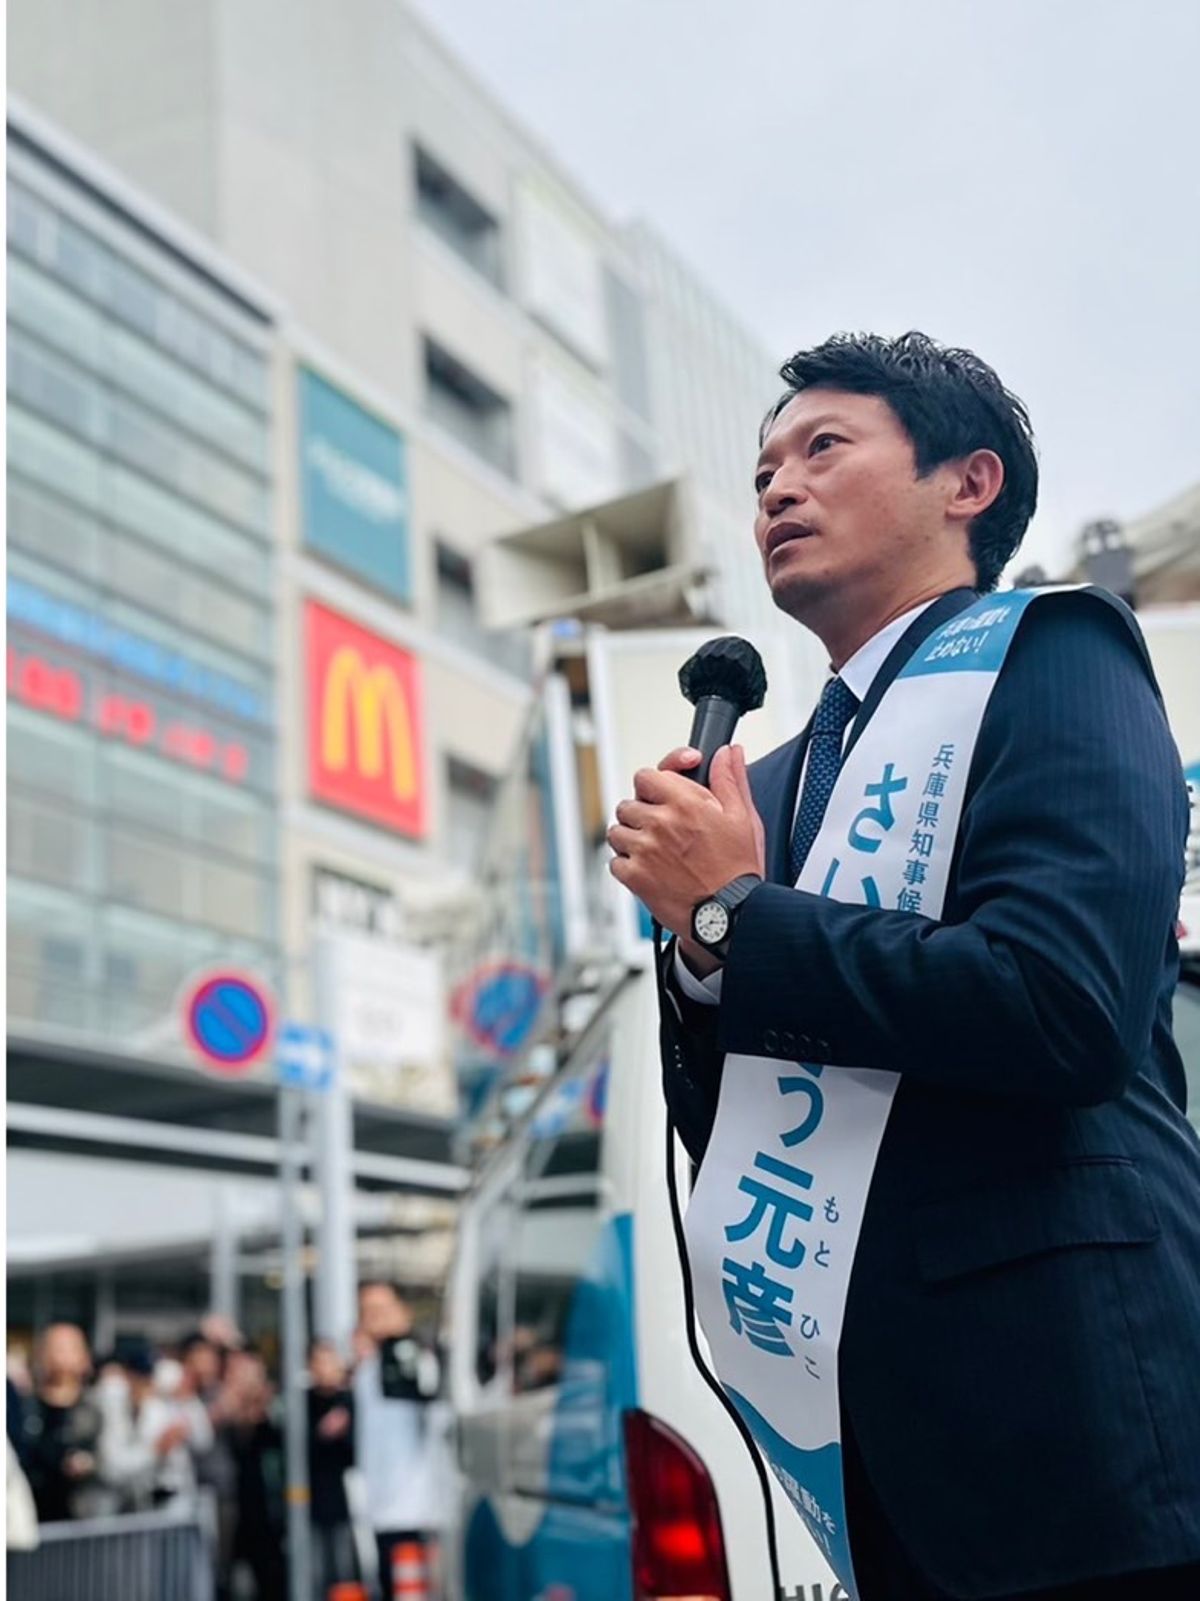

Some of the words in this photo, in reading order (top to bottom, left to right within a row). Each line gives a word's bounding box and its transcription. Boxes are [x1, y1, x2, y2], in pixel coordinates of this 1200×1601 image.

[897, 744, 956, 913] 兵庫県知事候
[800, 1196, 841, 1380] もとひこ
